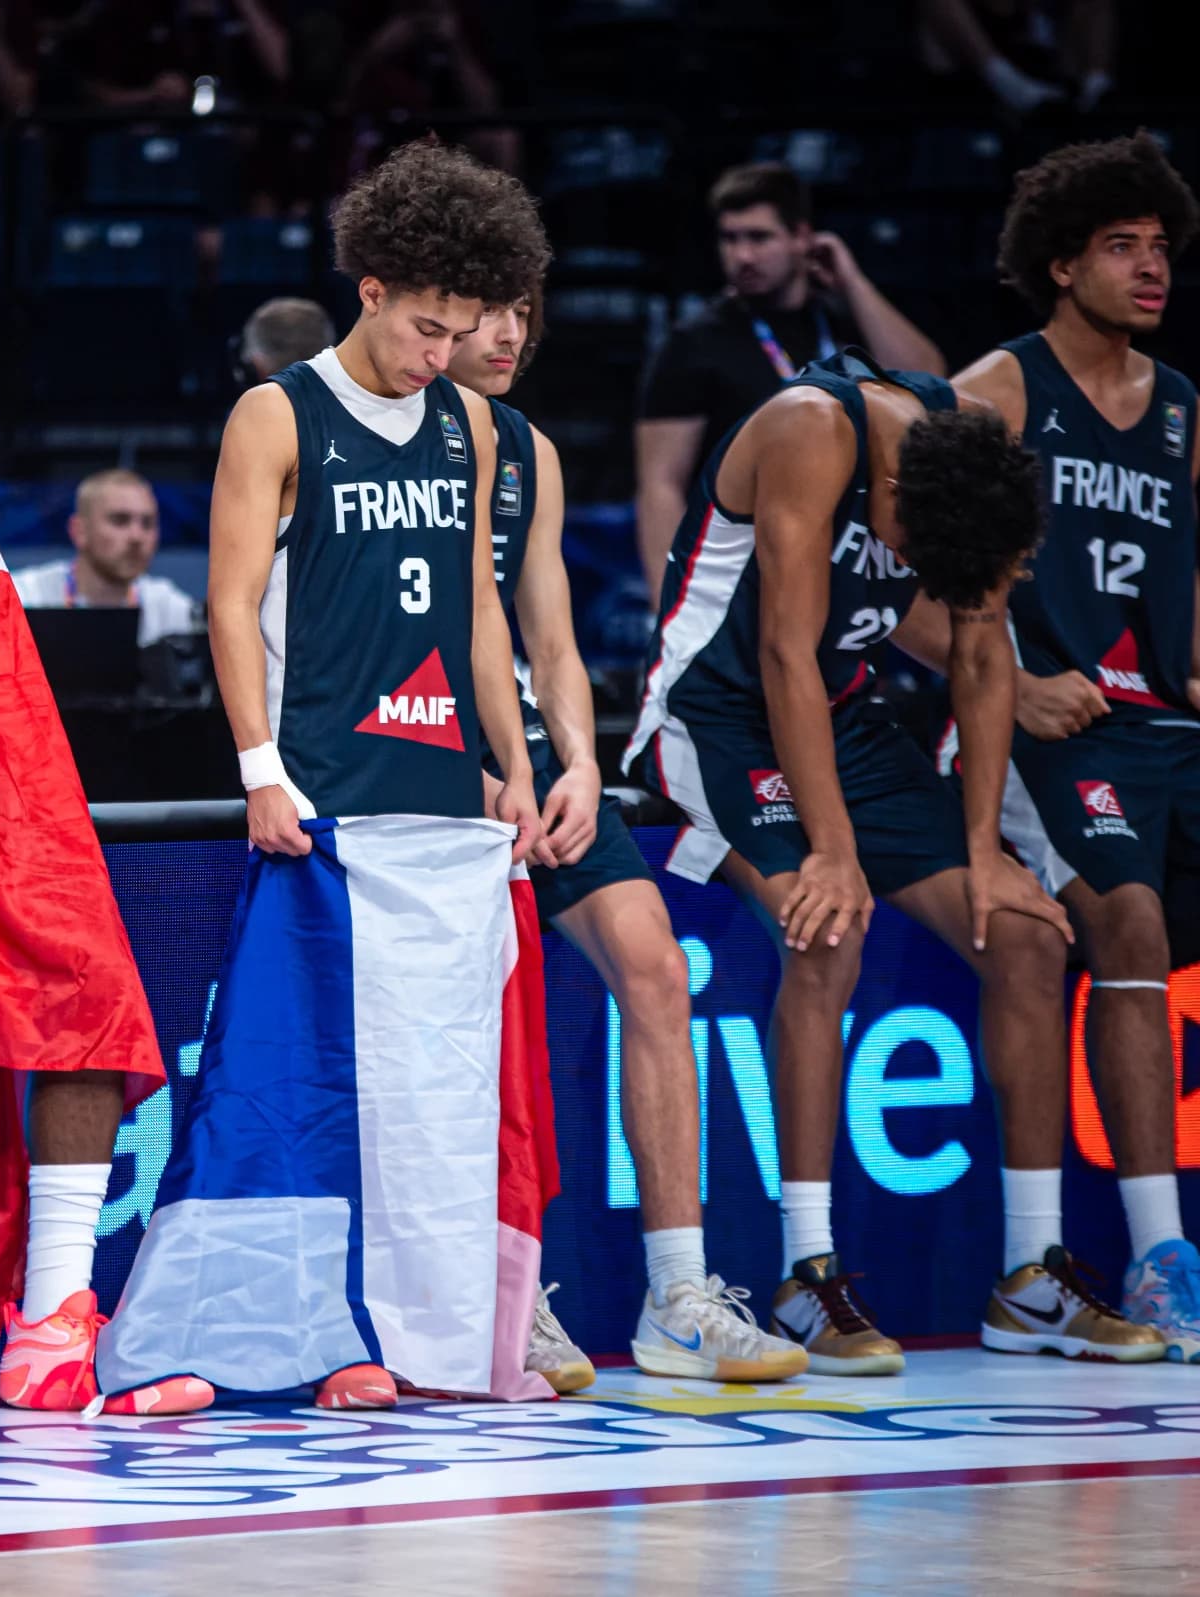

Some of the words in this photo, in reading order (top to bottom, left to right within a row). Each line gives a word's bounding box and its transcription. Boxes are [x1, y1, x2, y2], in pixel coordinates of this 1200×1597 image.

[332, 479, 467, 534] FRANCE
[1052, 456, 1173, 529] FRANCE
[399, 557, 431, 614] 3
[1087, 537, 1146, 599] 12
[378, 695, 456, 726] MAIF
[762, 804, 794, 815] CAISS
